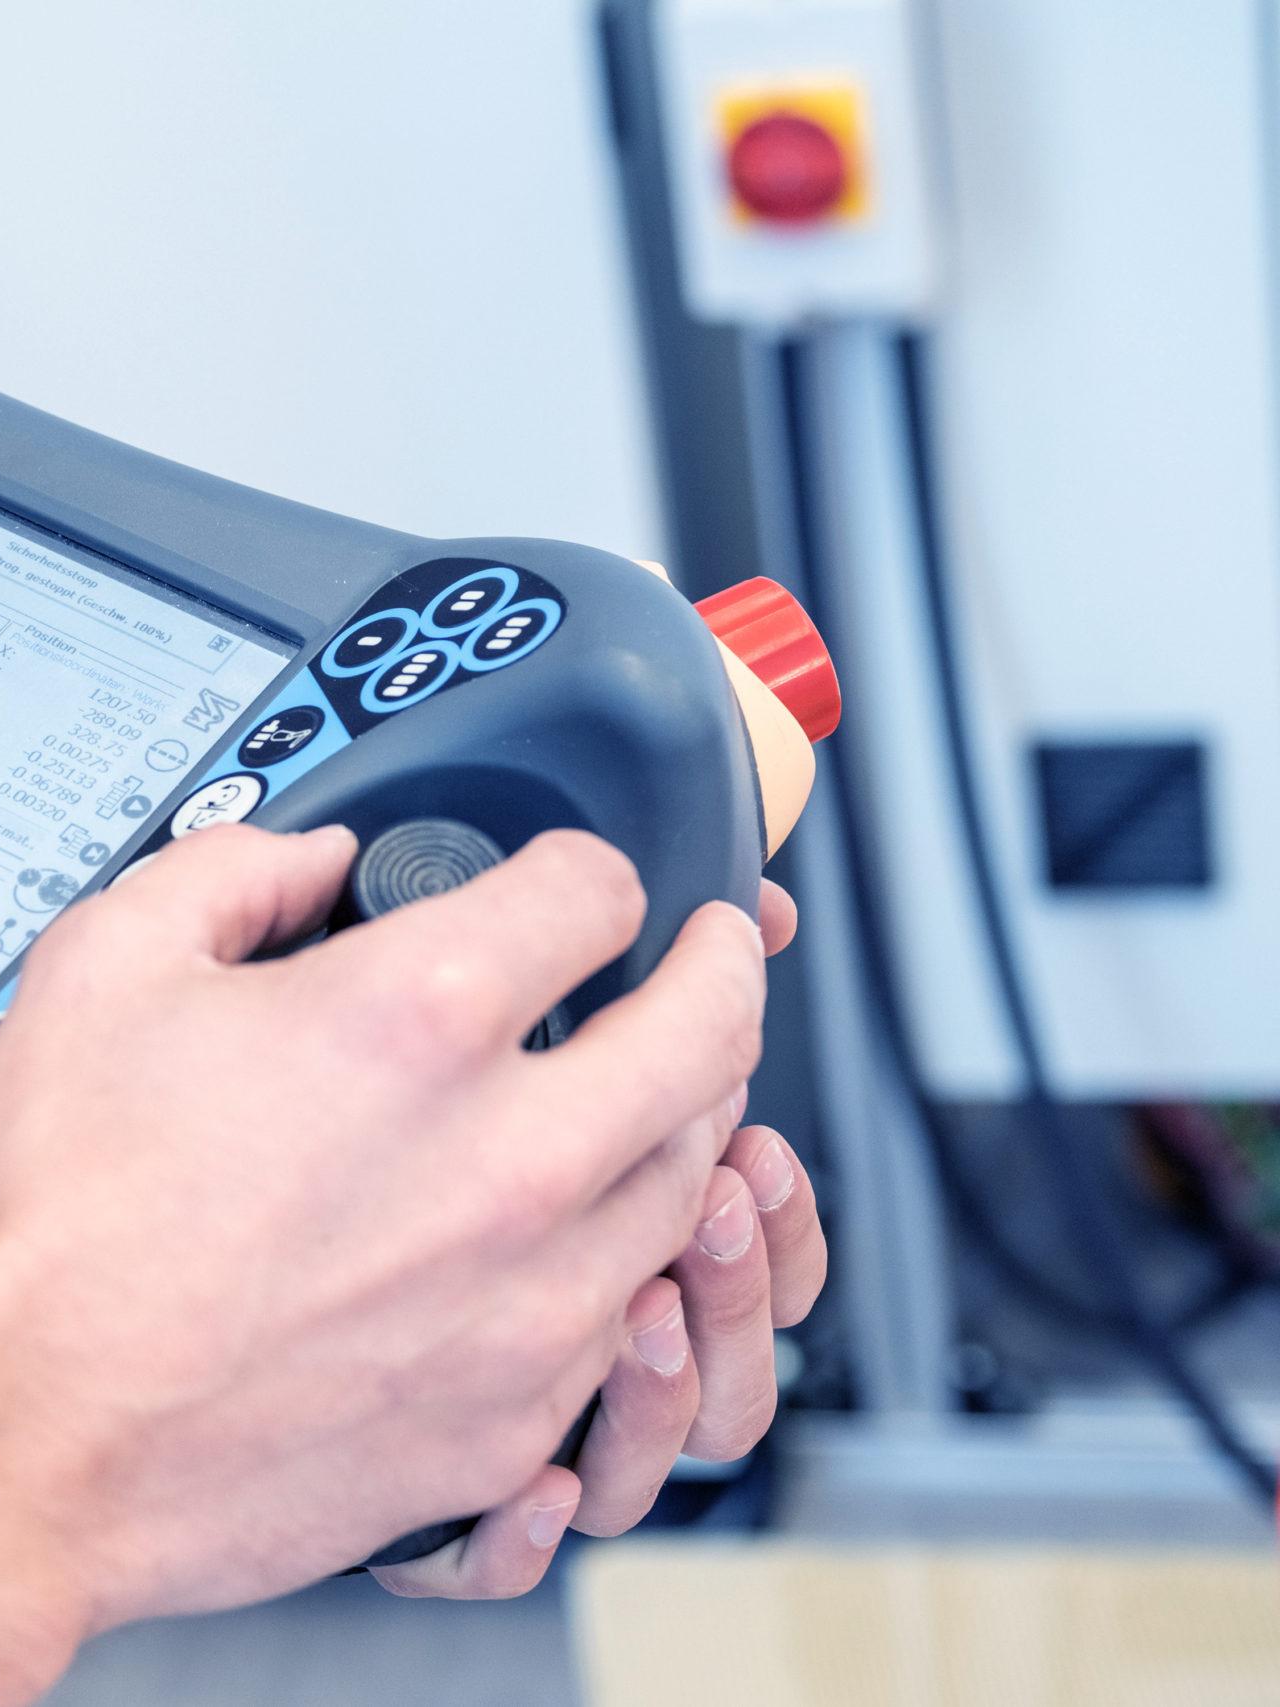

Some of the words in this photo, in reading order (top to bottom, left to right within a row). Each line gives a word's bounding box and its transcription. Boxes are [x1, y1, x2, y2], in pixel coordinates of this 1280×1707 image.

[5, 540, 99, 589] Sicherheitsstopp
[23, 571, 77, 600] gestoppt
[131, 620, 173, 645] 100%)
[23, 623, 78, 655] Position
[77, 706, 143, 741] -289.09
[87, 687, 157, 726] 1207.50
[40, 733, 112, 774] 0.00275
[65, 721, 129, 758] 328.75
[7, 765, 83, 806] -0.96789
[21, 749, 97, 790] -0.25133
